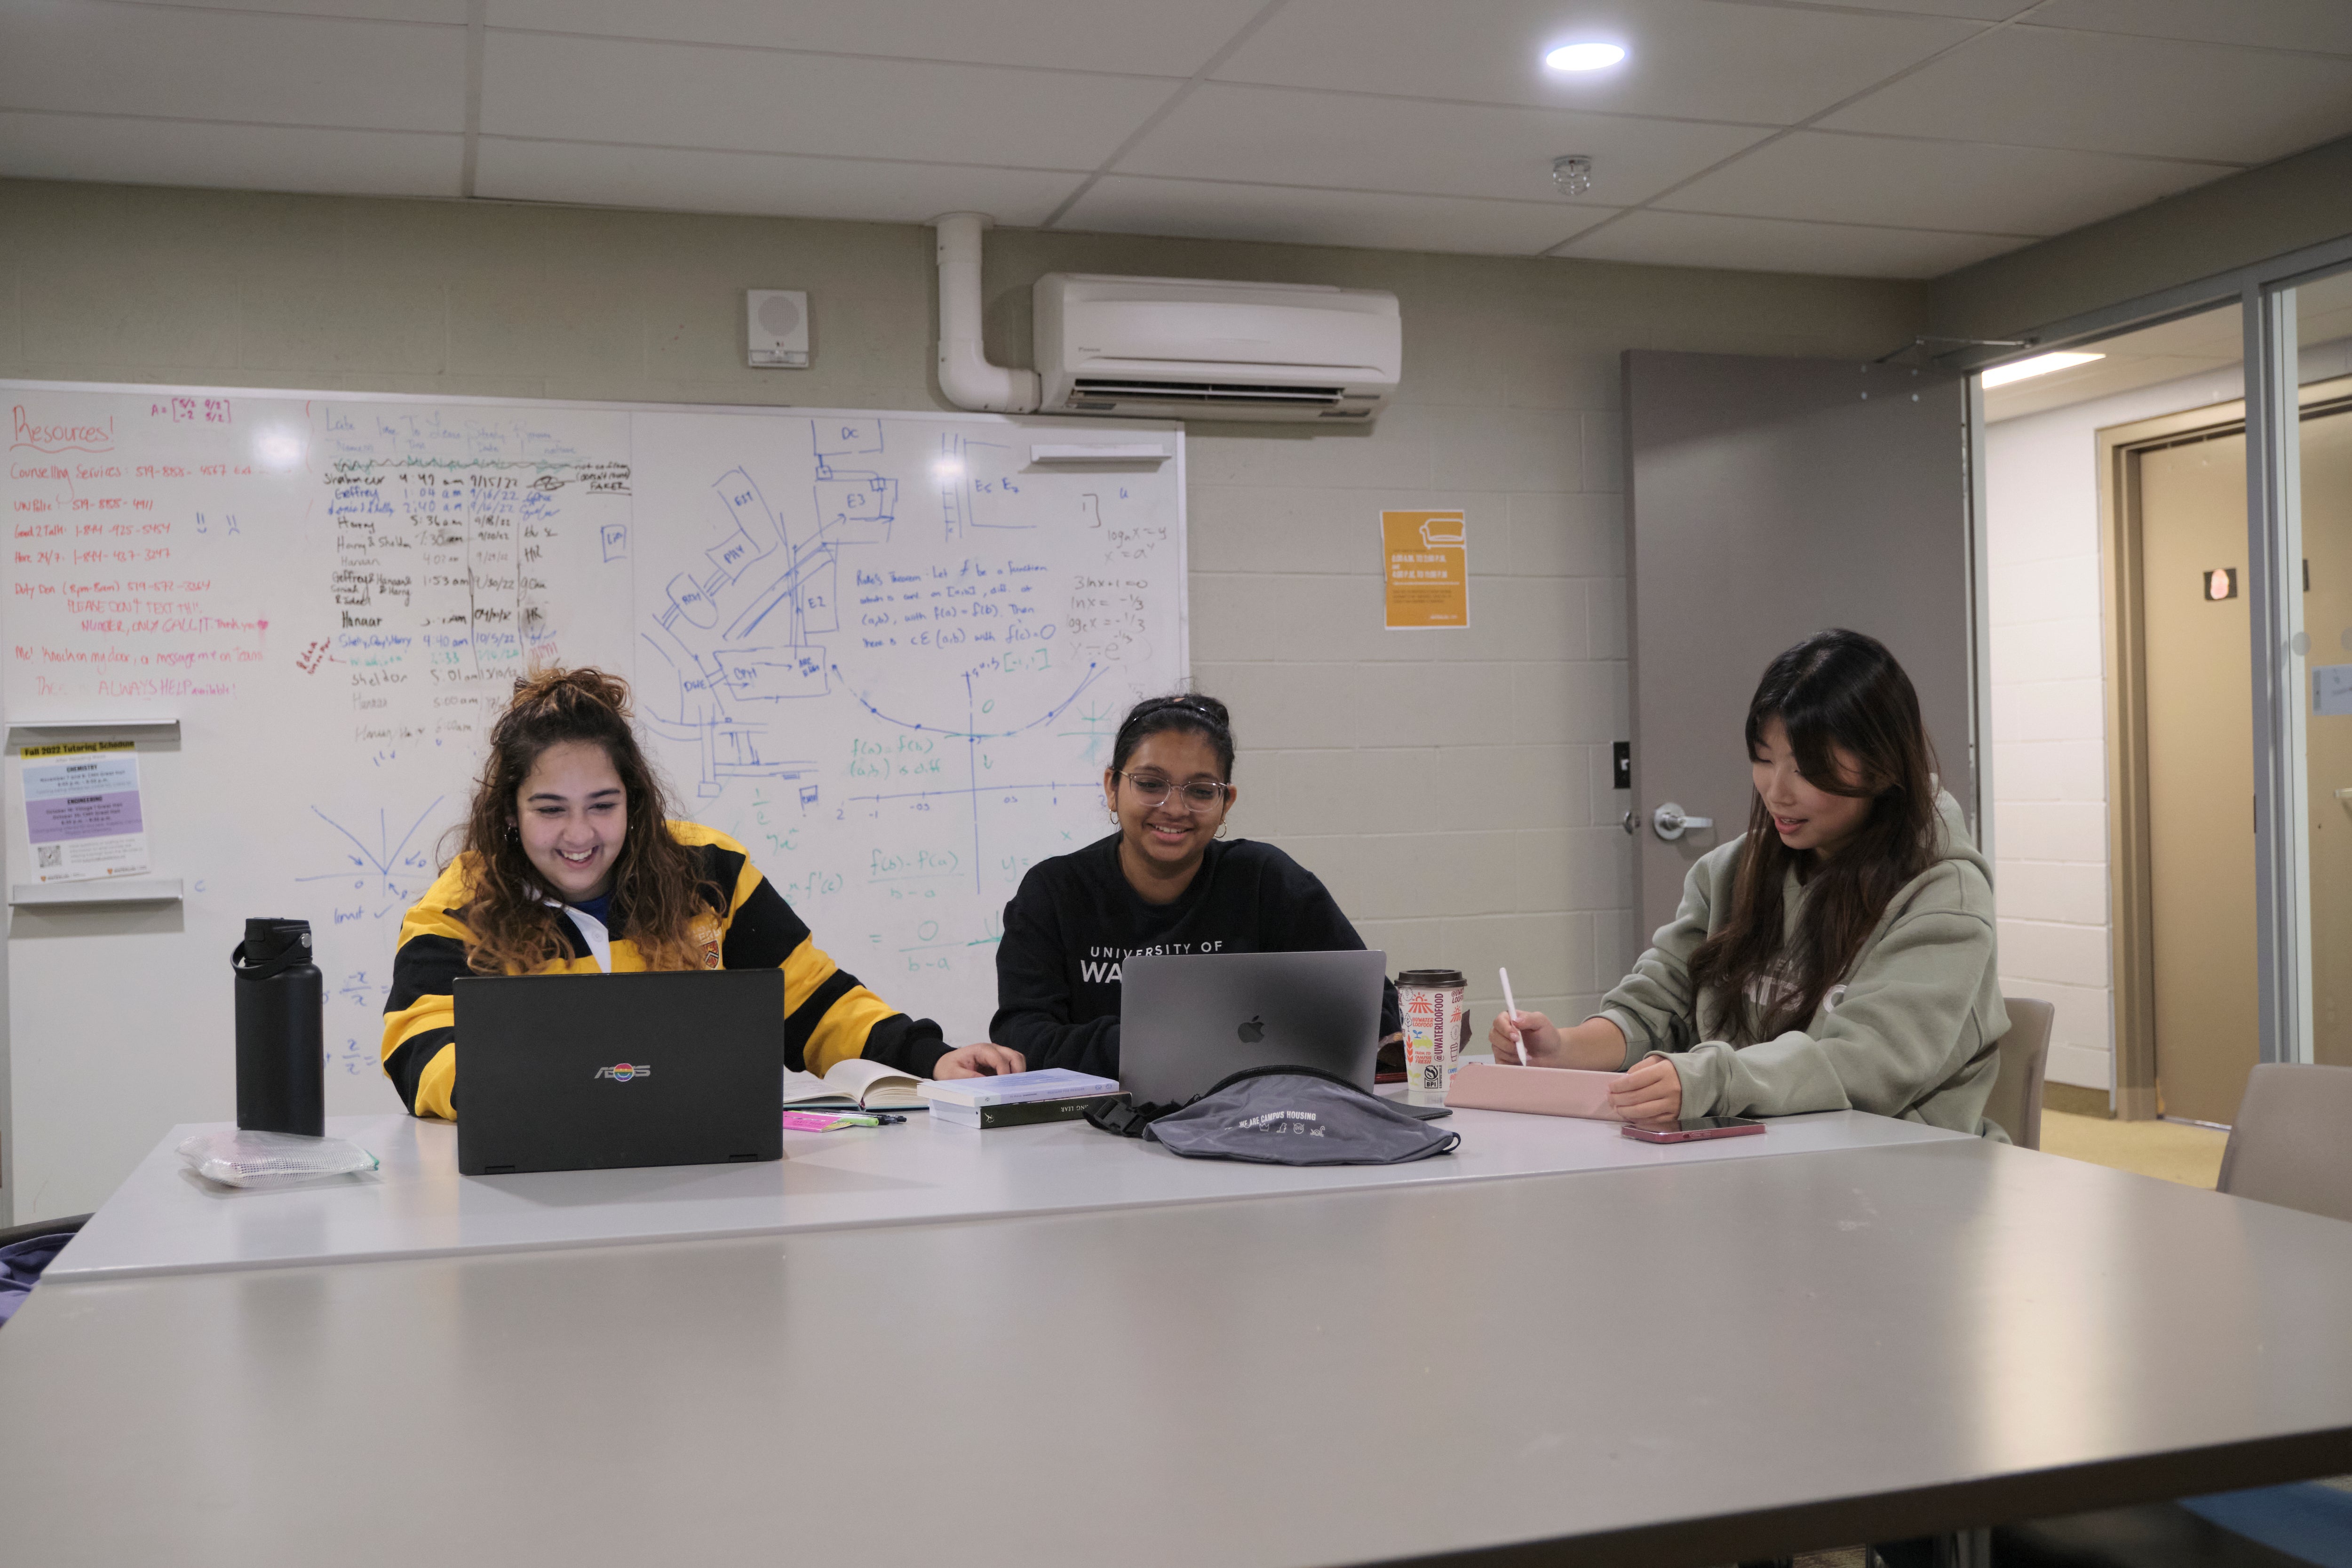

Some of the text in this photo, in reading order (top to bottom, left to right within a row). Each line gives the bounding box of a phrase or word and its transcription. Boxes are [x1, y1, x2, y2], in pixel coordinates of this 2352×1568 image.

[151, 405, 159, 416] A
[13, 405, 113, 443] Resources!
[841, 427, 859, 440] DC
[847, 493, 866, 509] E3
[932, 565, 947, 579] Let
[976, 563, 986, 577] be
[15, 582, 34, 600] Duty
[67, 599, 173, 614] PLEASE TEXT
[808, 596, 826, 608] E2
[1008, 603, 1035, 615] Then
[132, 620, 159, 634] ONLY
[162, 618, 197, 634] CALL
[98, 678, 158, 696] ALWAYS
[160, 678, 191, 696] HELP
[24, 748, 40, 756] Fall
[41, 745, 61, 755] 2022
[63, 743, 97, 753] Tutoring
[66, 764, 98, 773] CHEMISTRY
[334, 905, 364, 925] limit
[1090, 940, 1223, 959] UNIVERSITY OF
[1434, 993, 1444, 1061] @UWATERLOOFOOD
[594, 1065, 651, 1079] ASS
[1249, 1116, 1260, 1125] ARE
[1261, 1111, 1284, 1122] CAMPUS
[1286, 1111, 1316, 1121] HOUSING
